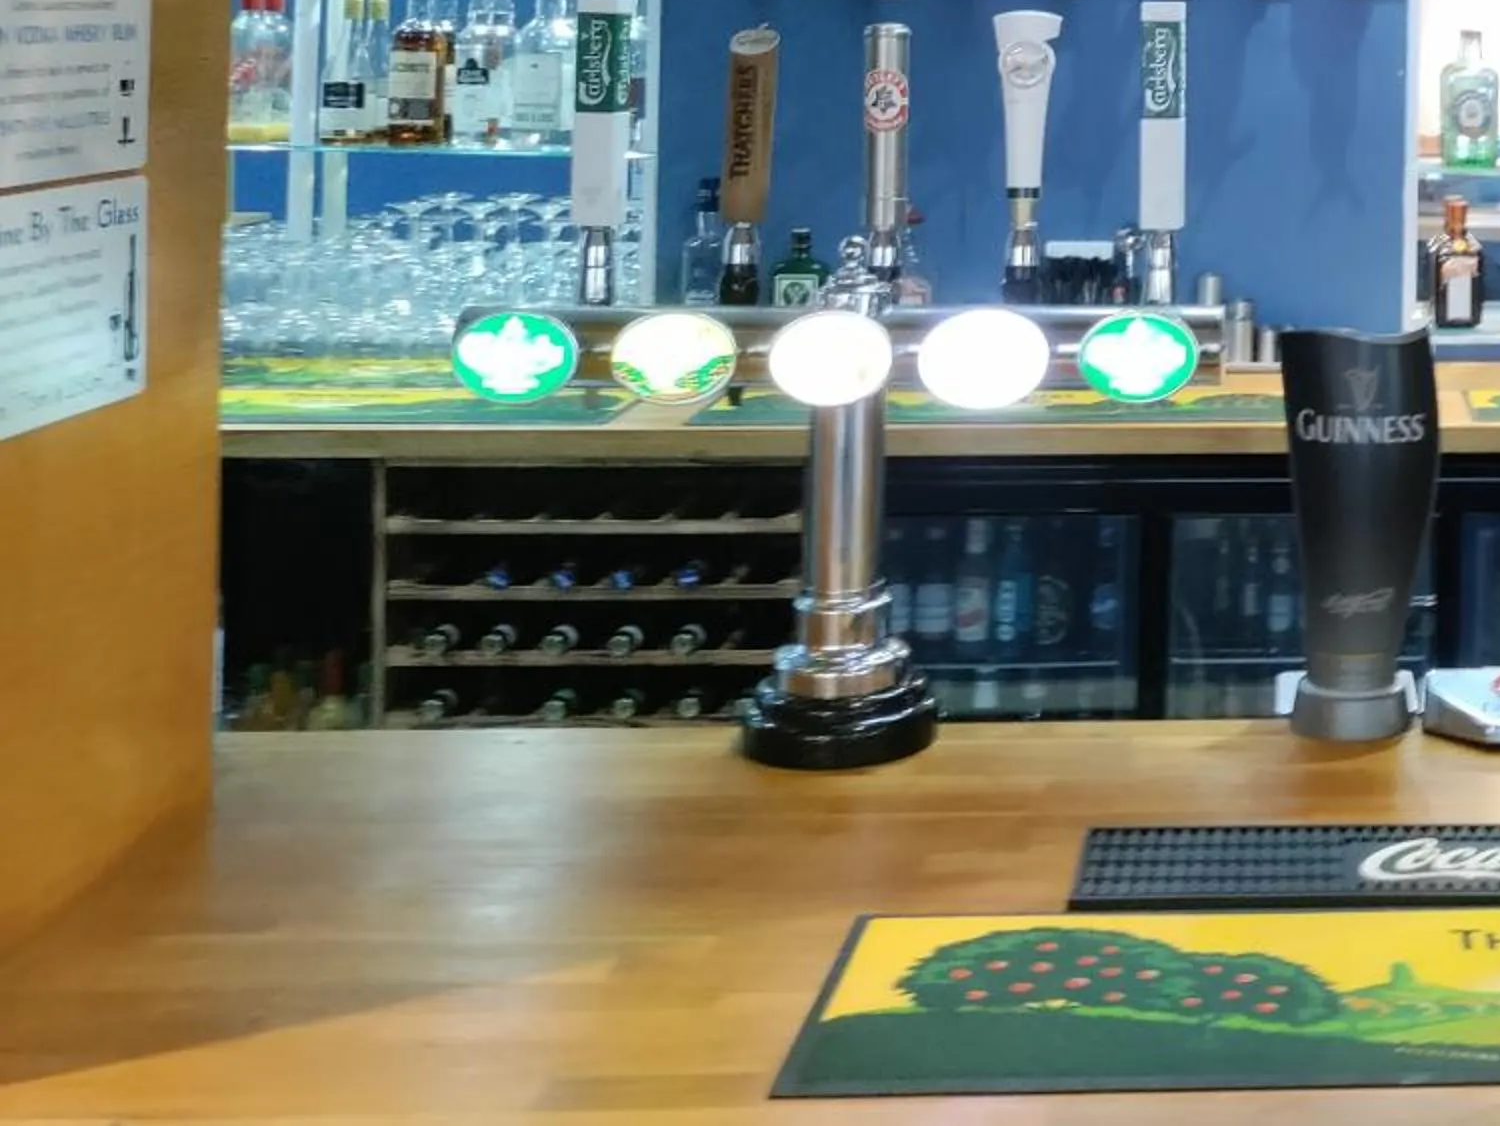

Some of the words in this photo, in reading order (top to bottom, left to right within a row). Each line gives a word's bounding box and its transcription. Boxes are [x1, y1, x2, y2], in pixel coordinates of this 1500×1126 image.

[579, 20, 612, 106] Carlsberg
[1145, 28, 1176, 112] Carlsberg
[98, 199, 140, 228] Glass
[1296, 408, 1426, 443] GUINNESS
